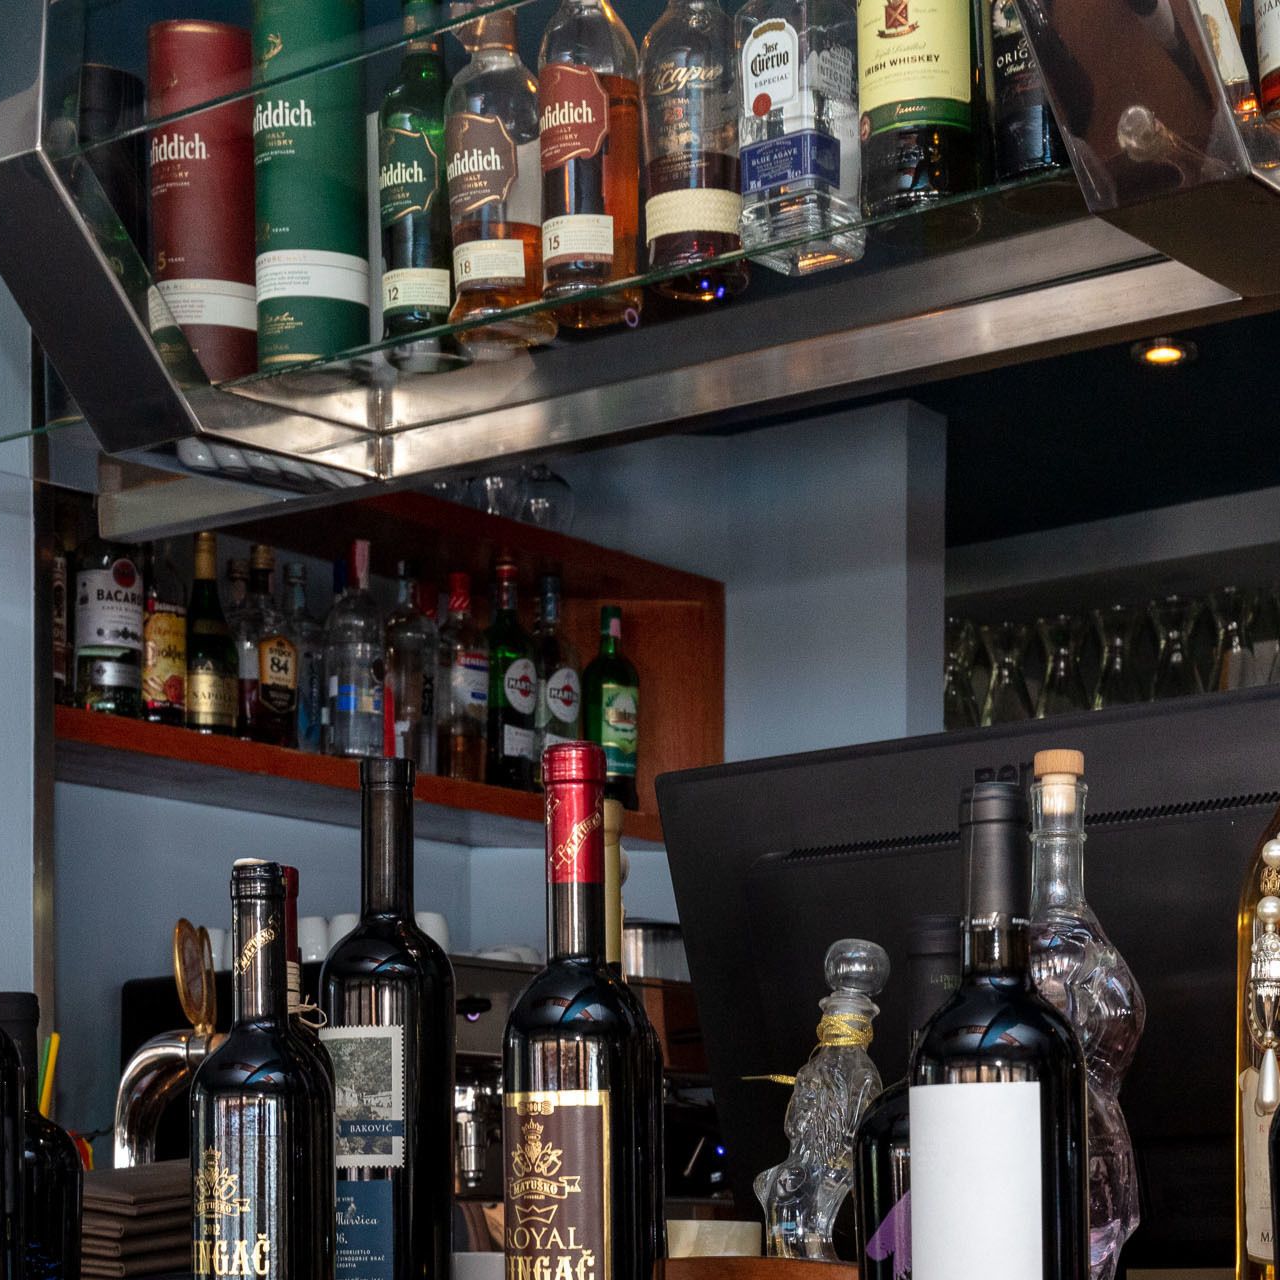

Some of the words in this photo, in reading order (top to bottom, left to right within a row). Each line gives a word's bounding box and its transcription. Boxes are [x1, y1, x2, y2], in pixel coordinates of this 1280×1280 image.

[751, 50, 789, 77] Cuervo
[865, 58, 886, 78] IRISH
[890, 54, 940, 70] WHISKEY
[997, 49, 1029, 69] ORIG
[754, 74, 788, 88] ESPECIAL
[752, 154, 770, 166] BLUE
[773, 147, 798, 160] AGAVE
[548, 235, 560, 251] 15
[460, 261, 471, 275] 18
[388, 287, 399, 301] 12
[270, 657, 289, 674] 84
[350, 1122, 393, 1133] BAKOVIĆ
[506, 1226, 583, 1250] ROYAL
